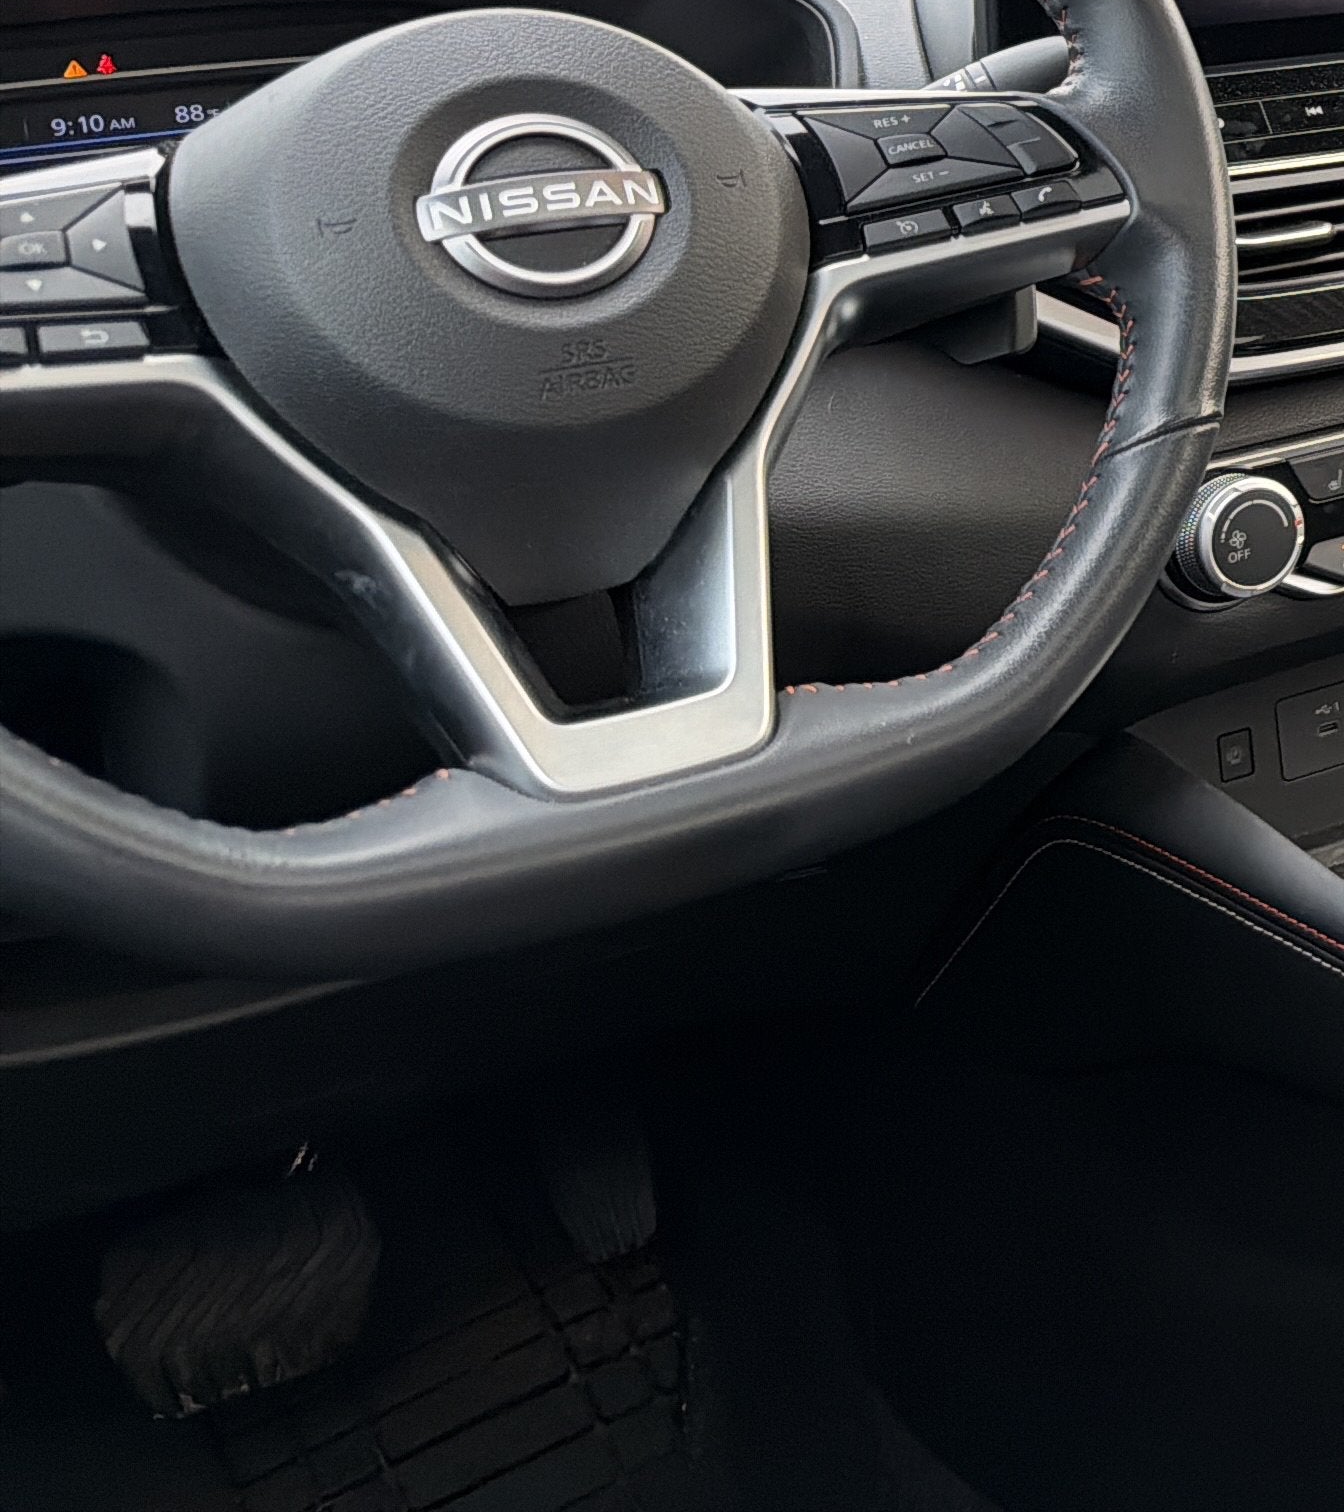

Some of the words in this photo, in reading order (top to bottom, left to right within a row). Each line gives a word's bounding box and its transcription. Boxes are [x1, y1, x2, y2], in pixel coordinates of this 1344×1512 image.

[50, 114, 105, 137] 9:10
[109, 116, 136, 131] AM
[873, 116, 899, 129] RES
[887, 139, 934, 155] CANCEL
[912, 171, 934, 184] SET
[430, 178, 660, 233] NISSAN
[17, 242, 47, 256] OK
[561, 339, 607, 363] SRS
[1227, 547, 1252, 564] OFF
